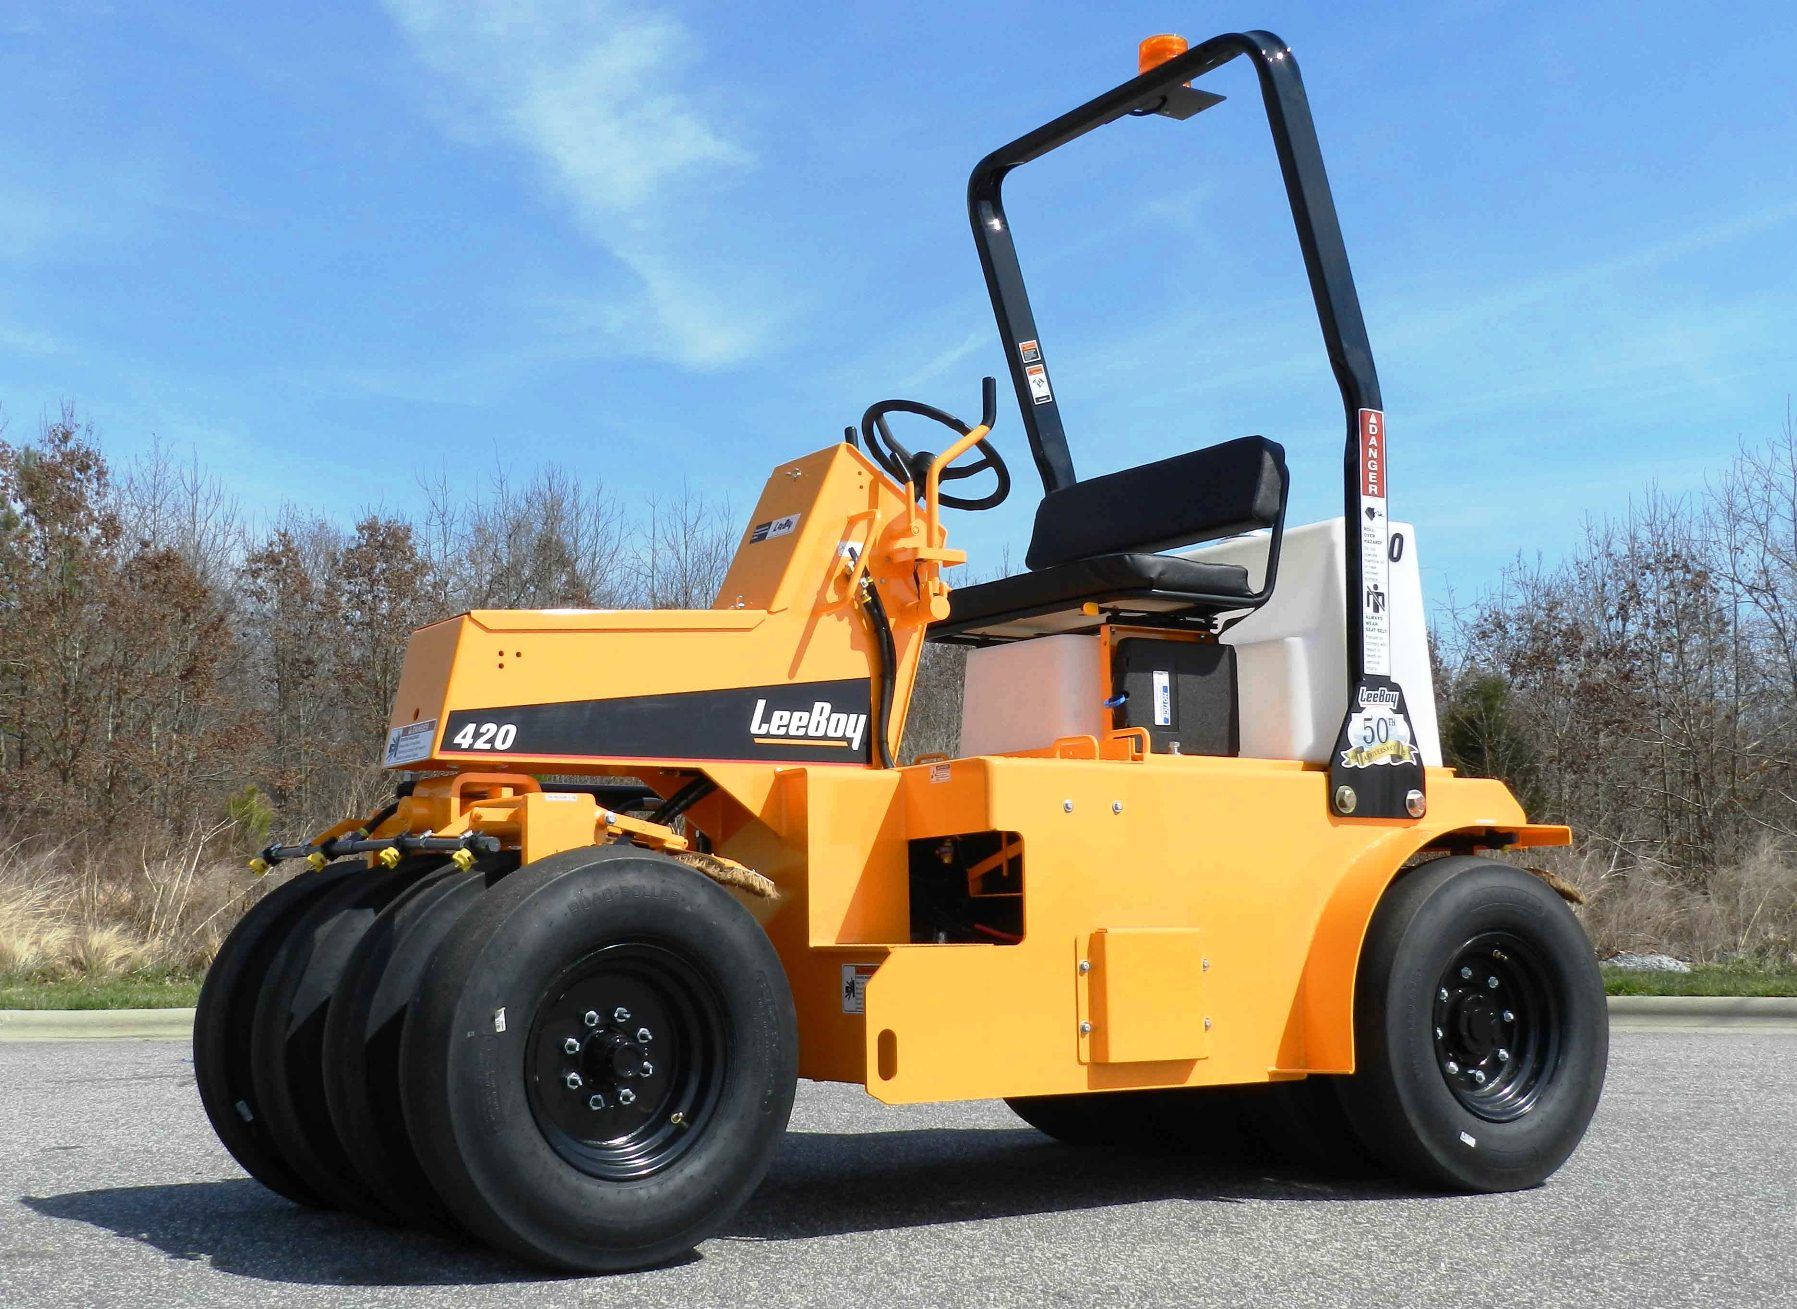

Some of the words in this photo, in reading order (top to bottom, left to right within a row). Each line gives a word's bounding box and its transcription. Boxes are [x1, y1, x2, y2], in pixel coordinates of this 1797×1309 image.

[1367, 423, 1378, 495] DANGER
[1360, 688, 1398, 707] LeeBoy
[453, 723, 517, 751] 420
[750, 699, 867, 751] LeeBoy
